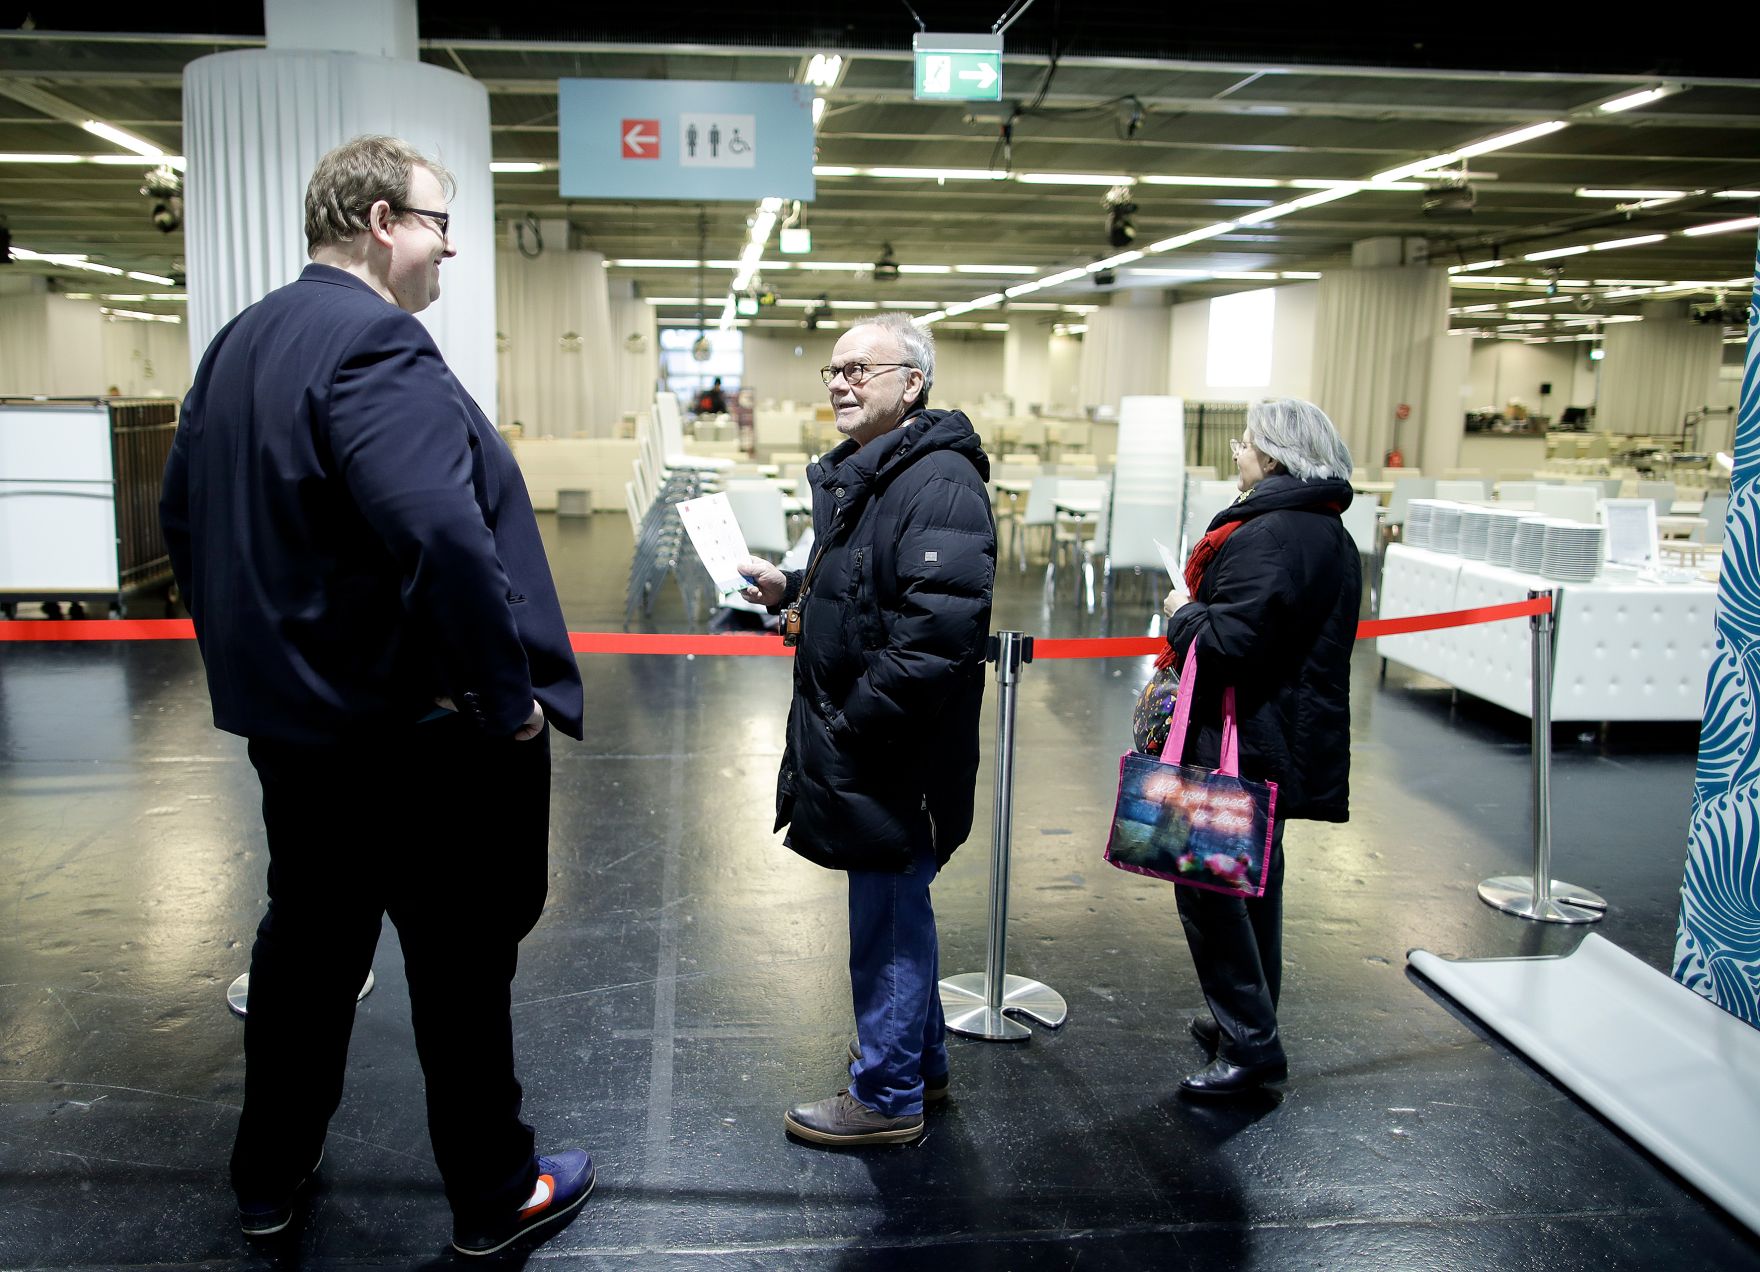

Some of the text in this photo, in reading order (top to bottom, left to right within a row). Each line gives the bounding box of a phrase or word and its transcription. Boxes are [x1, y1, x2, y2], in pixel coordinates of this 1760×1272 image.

[1182, 789, 1208, 806] you
[1211, 795, 1251, 808] need
[1210, 810, 1250, 827] love
